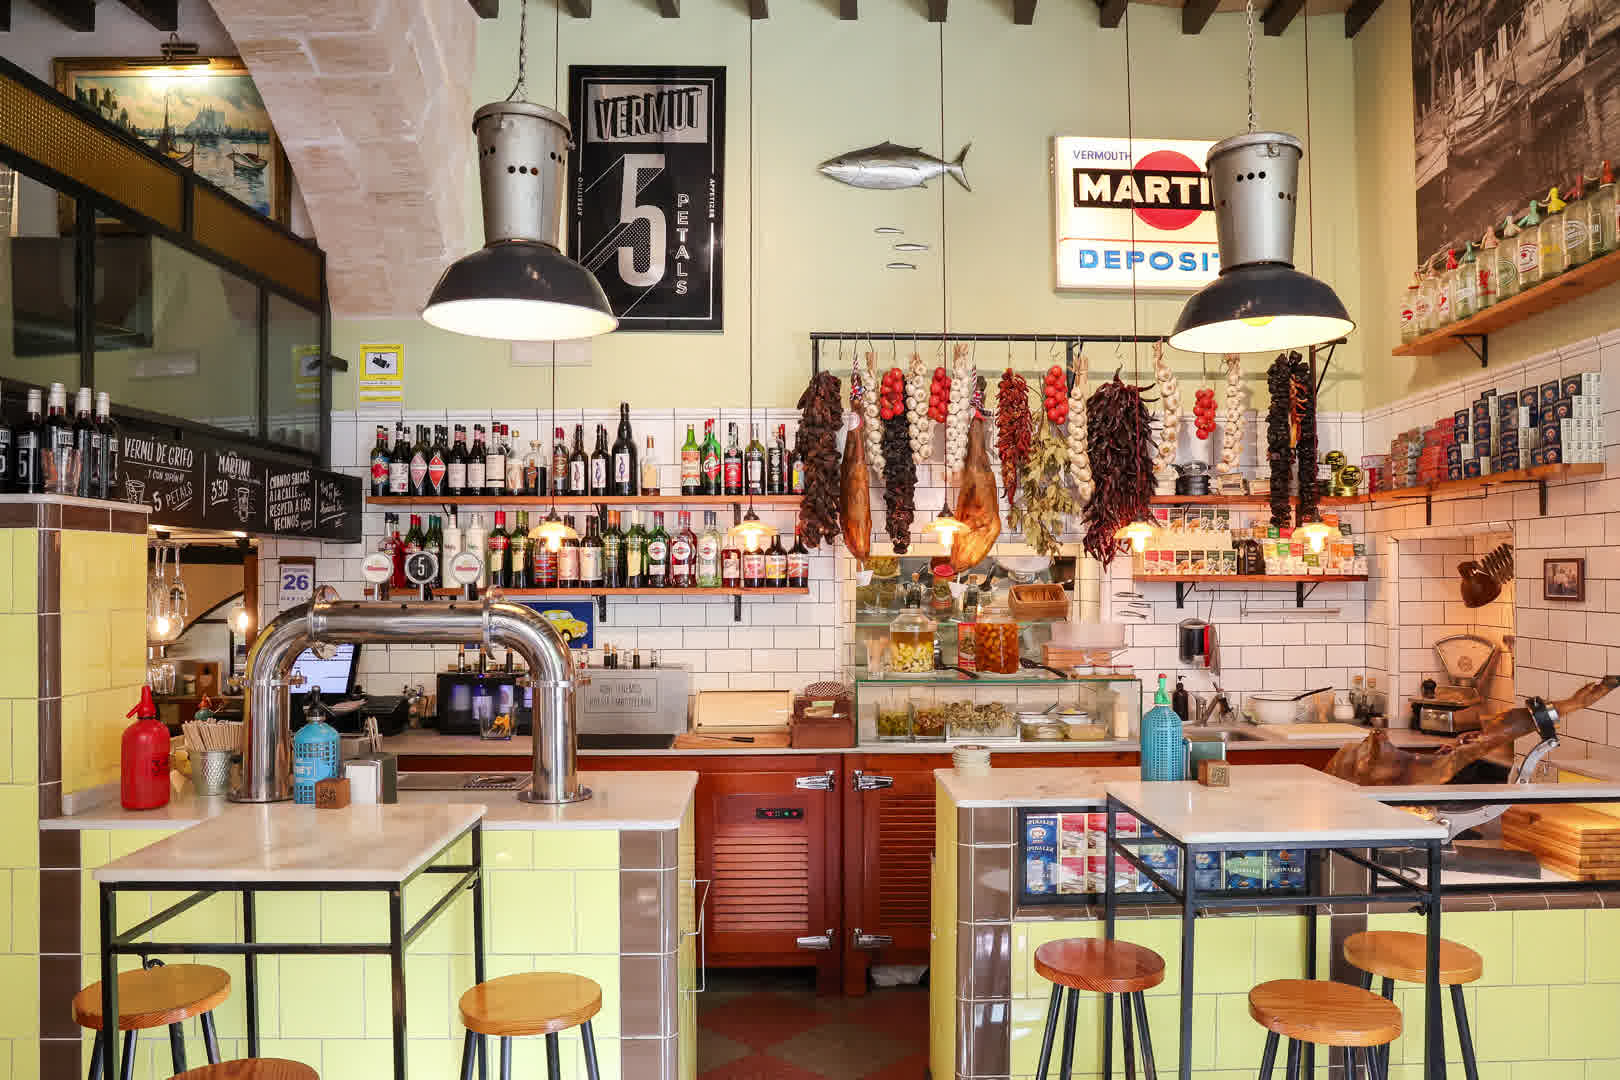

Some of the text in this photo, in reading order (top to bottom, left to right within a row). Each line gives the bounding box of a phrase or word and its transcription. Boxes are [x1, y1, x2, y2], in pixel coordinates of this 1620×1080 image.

[597, 87, 702, 140] VERMUT
[1073, 150, 1131, 161] VERMOUTH
[1078, 172, 1212, 205] MARTI
[617, 153, 667, 287] 5
[675, 193, 690, 295] PETALS
[19, 449, 28, 478] 5
[156, 442, 167, 464] DE
[168, 446, 193, 468] GRIFO
[152, 481, 193, 512] 5 PETALS
[269, 500, 295, 518] RESPETA
[300, 497, 312, 513] LOS
[273, 514, 300, 532] VECINOS
[417, 556, 425, 576] 5
[283, 575, 309, 590] 26
